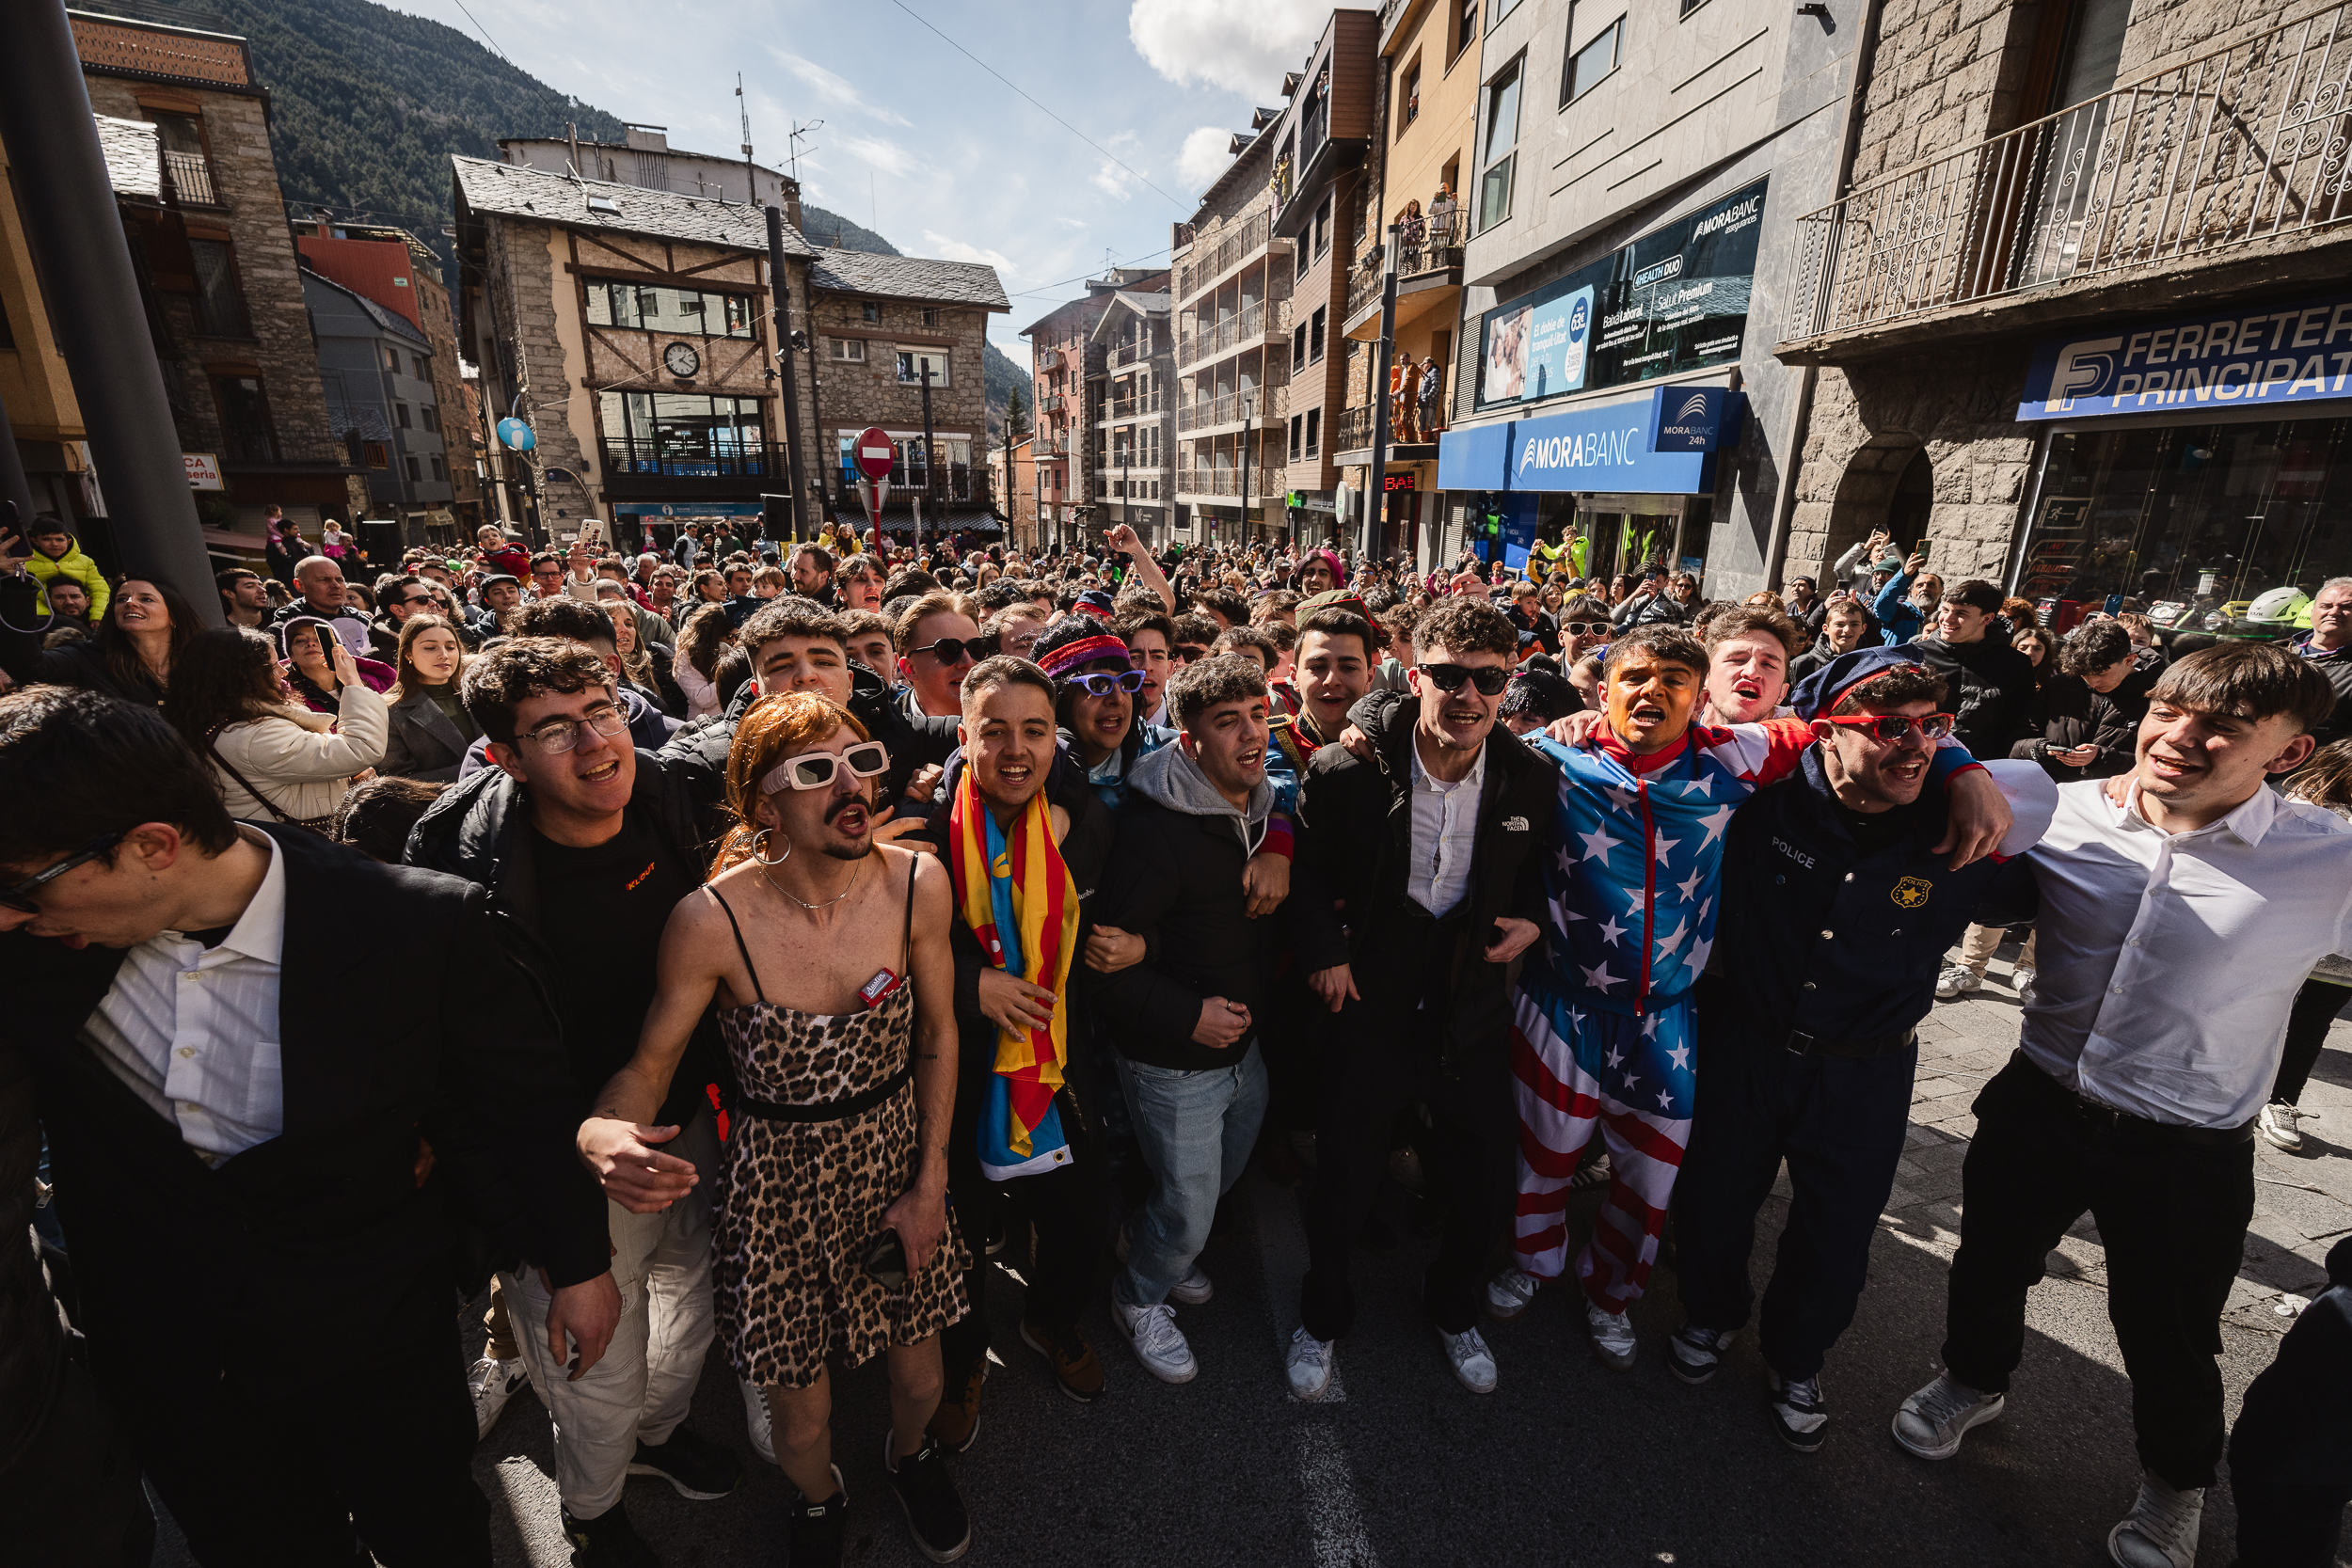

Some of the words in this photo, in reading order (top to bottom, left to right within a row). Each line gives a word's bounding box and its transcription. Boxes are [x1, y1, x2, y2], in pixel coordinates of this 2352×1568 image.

[1702, 195, 1760, 236] MORABANC
[1724, 214, 1757, 234] assegurances
[1635, 264, 1663, 286] 4HEALTH
[1663, 259, 1680, 277] DUO
[1658, 293, 1677, 311] Salut
[1677, 282, 1713, 305] Premium
[1534, 323, 1540, 338] El
[1540, 318, 1556, 335] doble
[1557, 315, 1565, 329] de
[1602, 314, 1620, 329] Baixa
[1619, 302, 1644, 324] Laboral
[1530, 356, 1539, 370] per
[1545, 352, 1552, 363] tu
[1531, 369, 1540, 382] els
[1663, 426, 1714, 436] MORABANC
[1688, 436, 1706, 445] 24h
[1534, 427, 1638, 469] MORABANC
[1772, 836, 1816, 869] POLICE
[626, 862, 655, 891] KLOUT
[1902, 878, 1930, 888] POLICE
